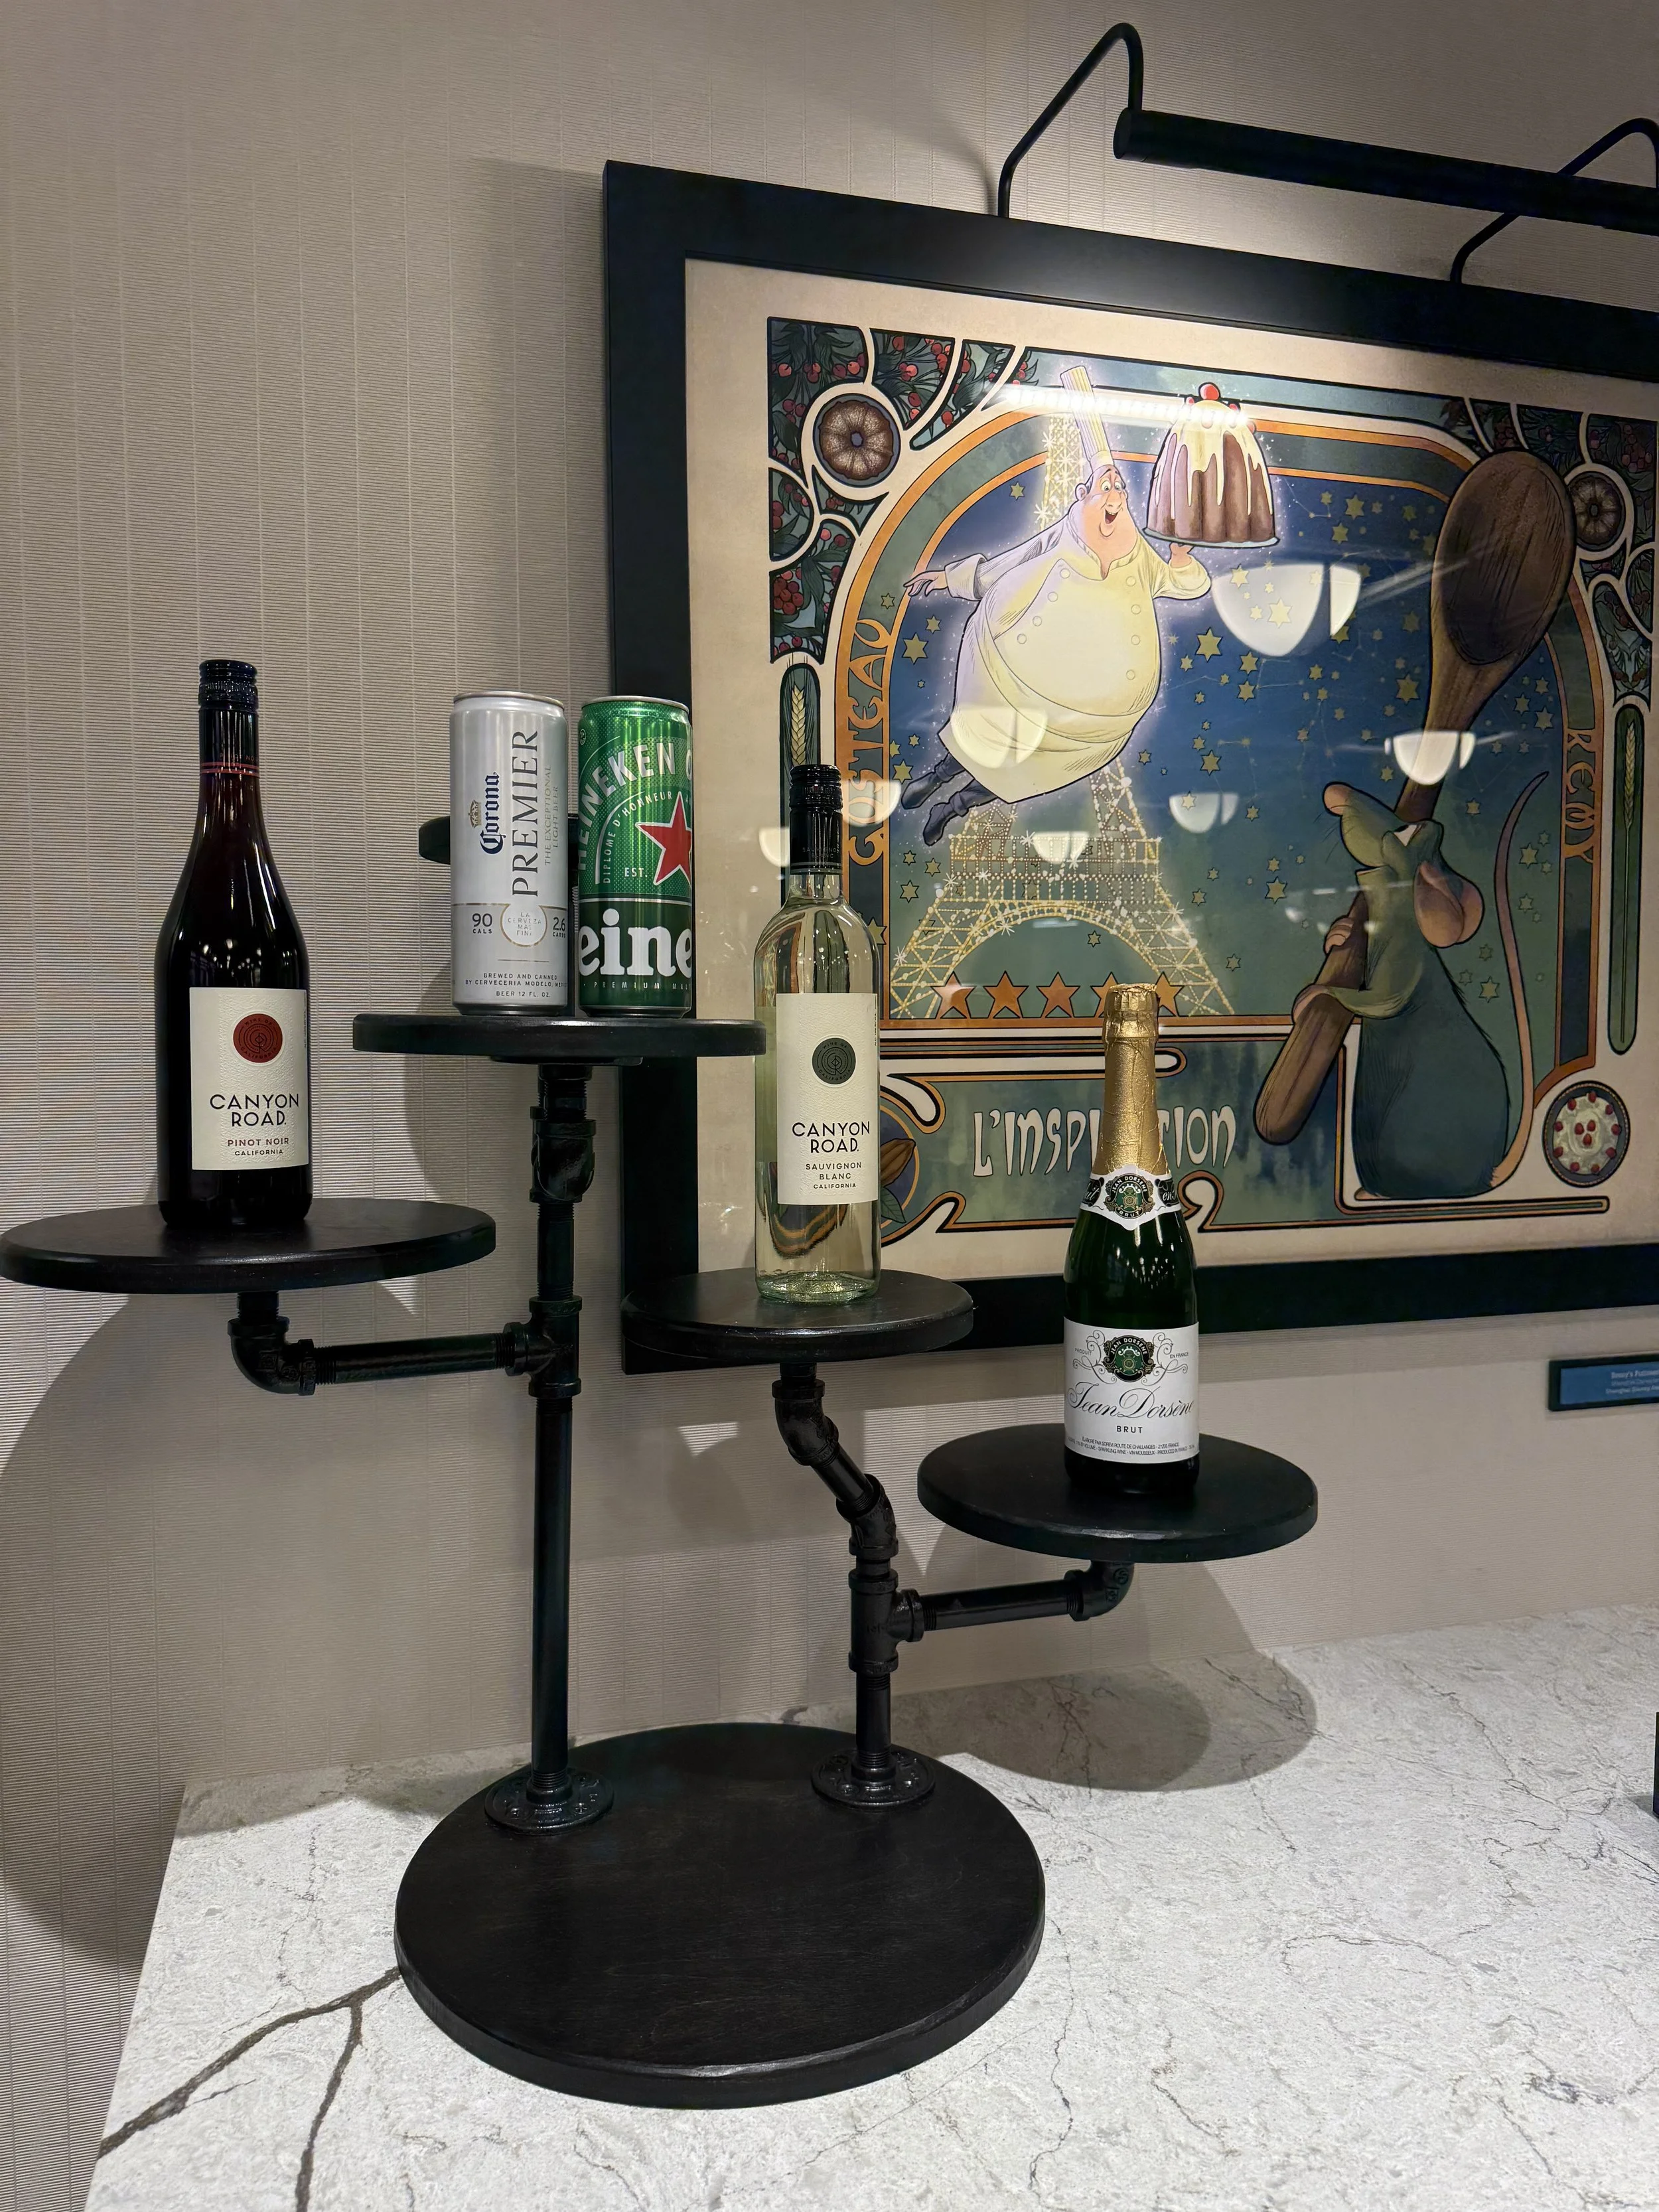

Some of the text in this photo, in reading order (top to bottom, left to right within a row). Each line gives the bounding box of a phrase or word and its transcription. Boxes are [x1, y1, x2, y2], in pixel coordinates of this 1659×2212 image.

[1563, 728, 1596, 863] REMY
[479, 771, 507, 855] Corona
[512, 730, 539, 897] PREMIER
[603, 790, 673, 884] DIPLOME D'HONNEUR
[624, 866, 648, 878] EST.
[471, 913, 493, 928] 90
[553, 917, 566, 932] 2.6
[593, 981, 660, 990] PREMIUM
[210, 1093, 299, 1110] CANYON
[792, 1121, 870, 1138] CANYON
[805, 1161, 862, 1170] SAUVIGNON
[1112, 1179, 1123, 1193] JEAN
[1074, 1347, 1092, 1356] PRODUIT
[1110, 1341, 1121, 1355] JEAN
[1067, 1381, 1194, 1419] Jean Dorsène
